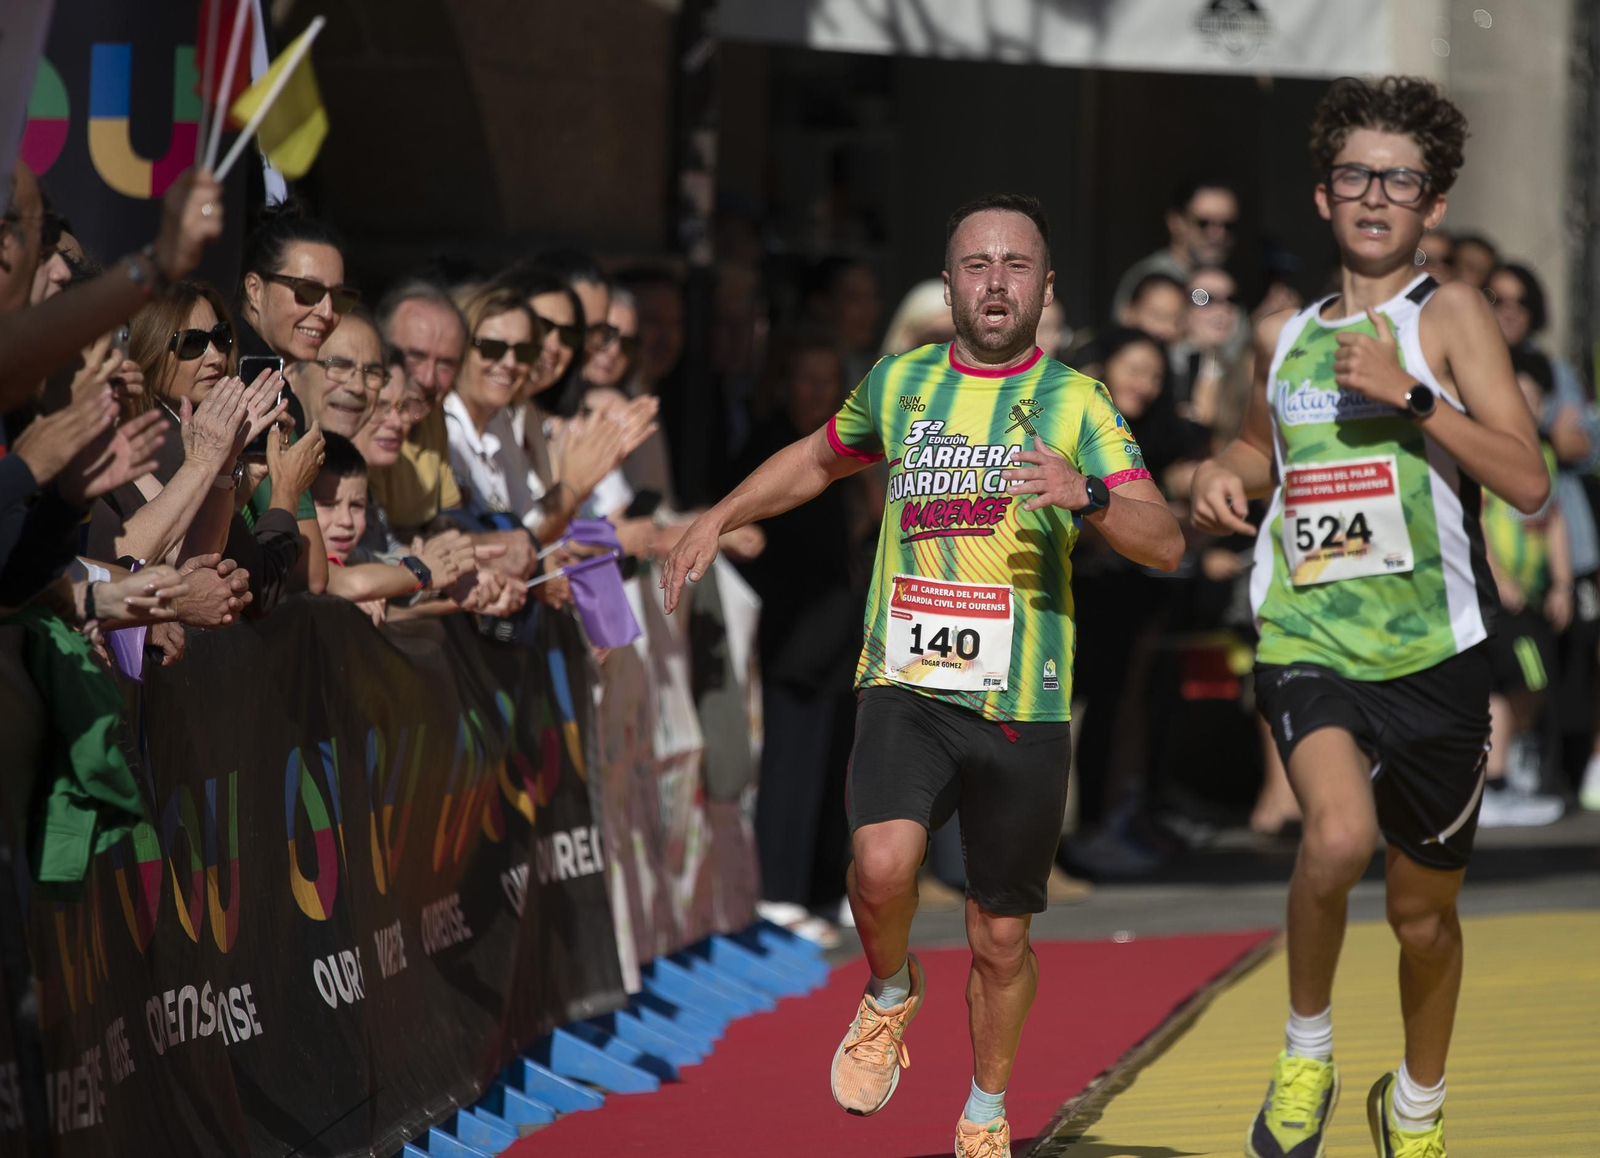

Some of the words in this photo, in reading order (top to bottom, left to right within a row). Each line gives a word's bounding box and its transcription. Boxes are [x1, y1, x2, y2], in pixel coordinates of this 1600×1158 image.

[899, 395, 921, 404] RUN
[928, 434, 968, 446] EDICIÓN
[903, 445, 1022, 469] CARRERA
[1350, 466, 1377, 479] PILAR
[889, 470, 977, 504] GUARDIA
[1296, 512, 1373, 551] 524
[920, 585, 955, 597] CARRERA
[956, 590, 971, 600] DEL
[973, 591, 997, 600] PILAR
[902, 594, 933, 606] GUARDIA
[934, 599, 955, 609] CIVIL
[956, 601, 967, 610] DE
[968, 602, 1006, 612] OURENSE
[909, 623, 981, 661] 140
[921, 658, 939, 668] EDGAR
[941, 660, 962, 670] GOMEZ
[313, 946, 366, 1010] OUR
